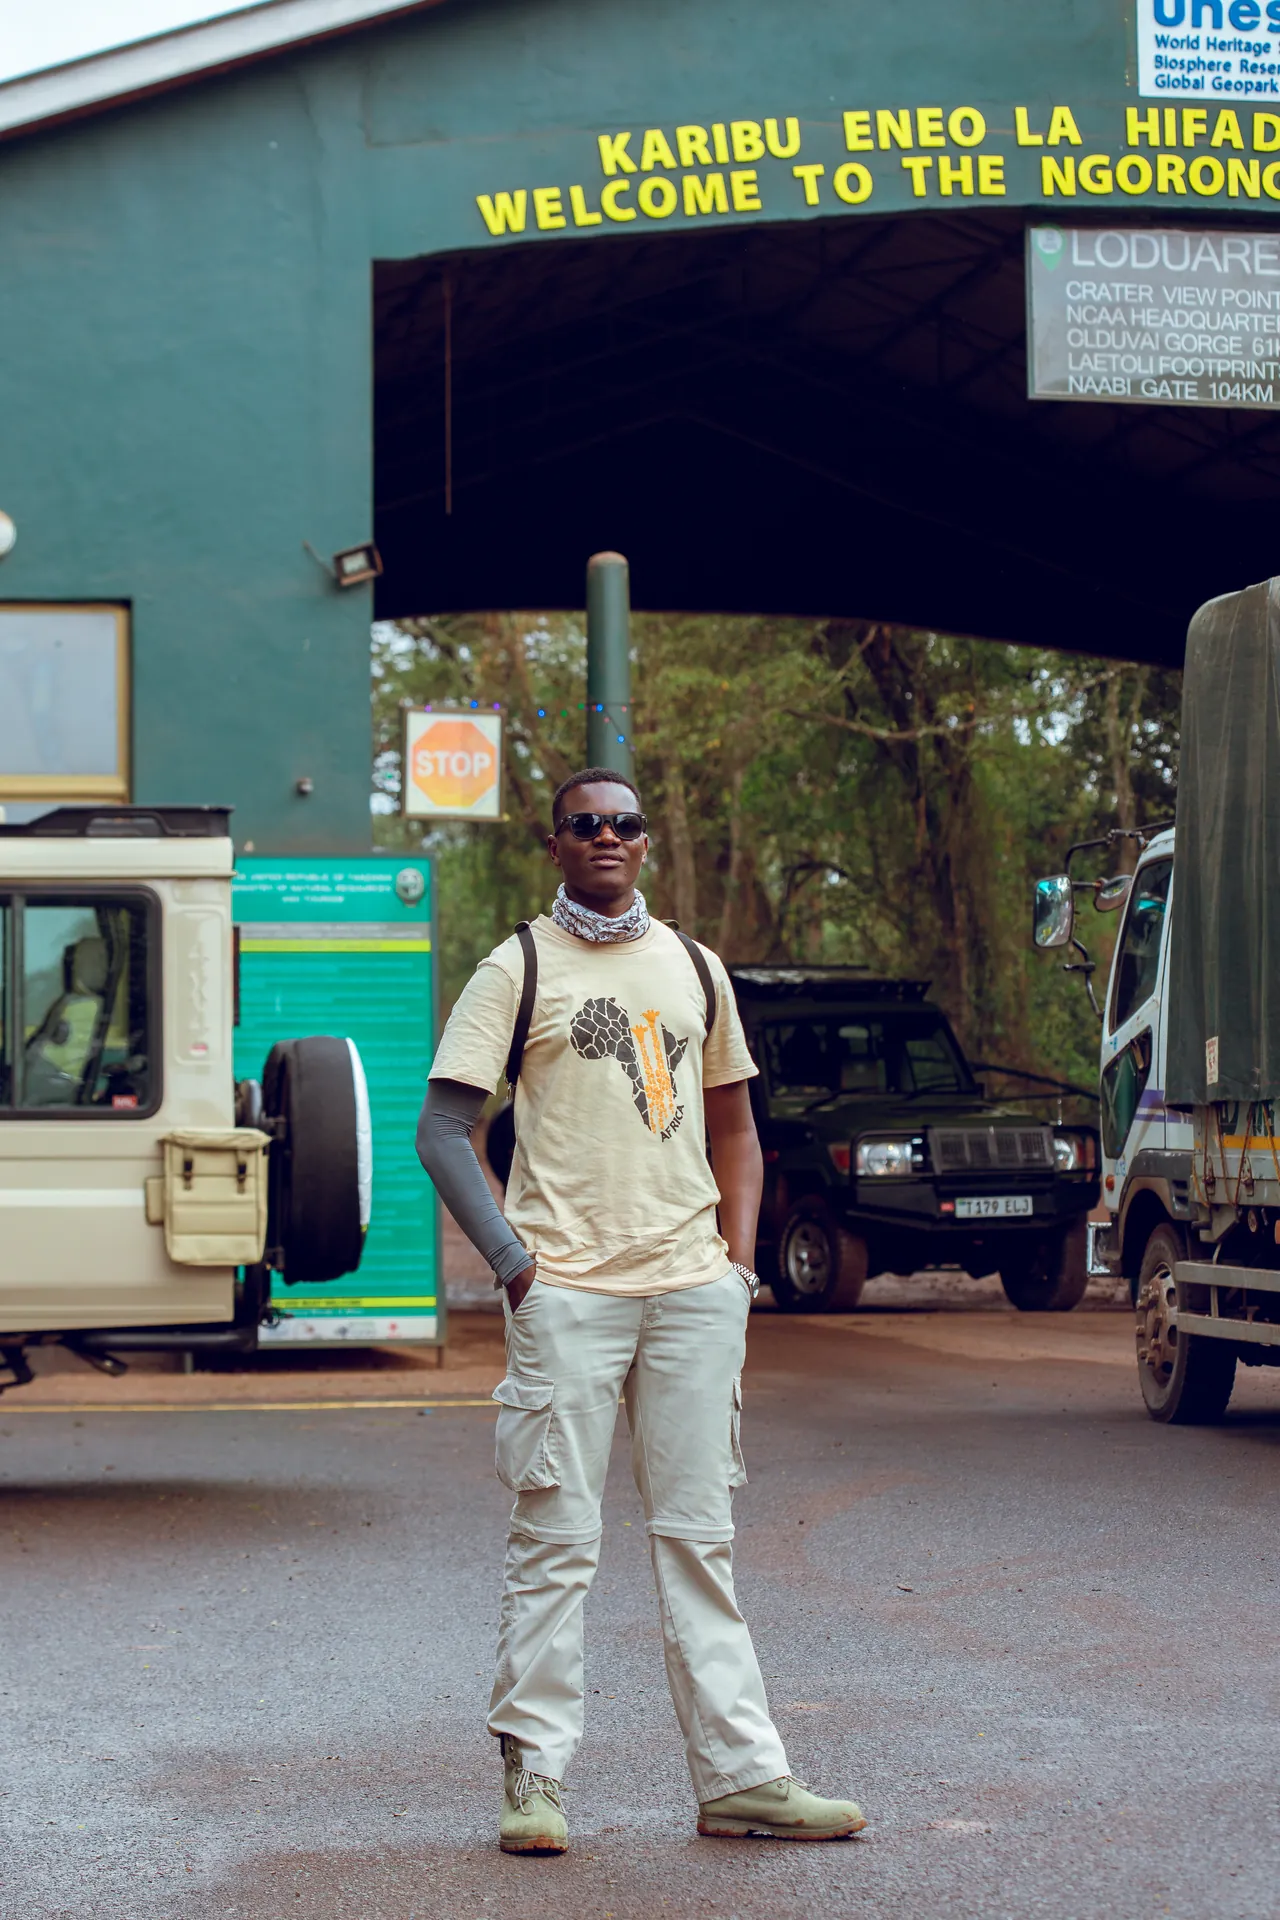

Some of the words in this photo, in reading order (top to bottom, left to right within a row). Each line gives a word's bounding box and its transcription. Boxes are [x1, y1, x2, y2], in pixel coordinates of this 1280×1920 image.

[1155, 34, 1200, 50] World
[1206, 36, 1272, 57] Heritage
[1154, 55, 1232, 73] Biosphere
[1154, 74, 1204, 89] Global
[1211, 76, 1279, 94] Geopark
[597, 117, 801, 176] KARIBU
[842, 106, 986, 151] ENEO
[1014, 106, 1083, 147] LA
[1125, 106, 1280, 152] HIFAD
[476, 169, 762, 236] WELCOME
[792, 162, 873, 205] TO
[902, 155, 1006, 197] THE
[1072, 230, 1280, 275] LODUARE
[1066, 281, 1153, 303] CRATER
[1162, 286, 1217, 305] VIEW
[1066, 305, 1127, 325] NCAA
[1067, 328, 1159, 350] OLDUVAI
[1164, 333, 1243, 355] GORGE
[1068, 352, 1154, 375] LAETOLI
[1159, 356, 1280, 381] FOOTPRINT
[1068, 375, 1131, 396] NAABI
[1141, 379, 1199, 400] GATE
[1209, 382, 1274, 403] 104KM
[416, 750, 492, 778] STOP
[660, 1104, 684, 1143] AFRICA
